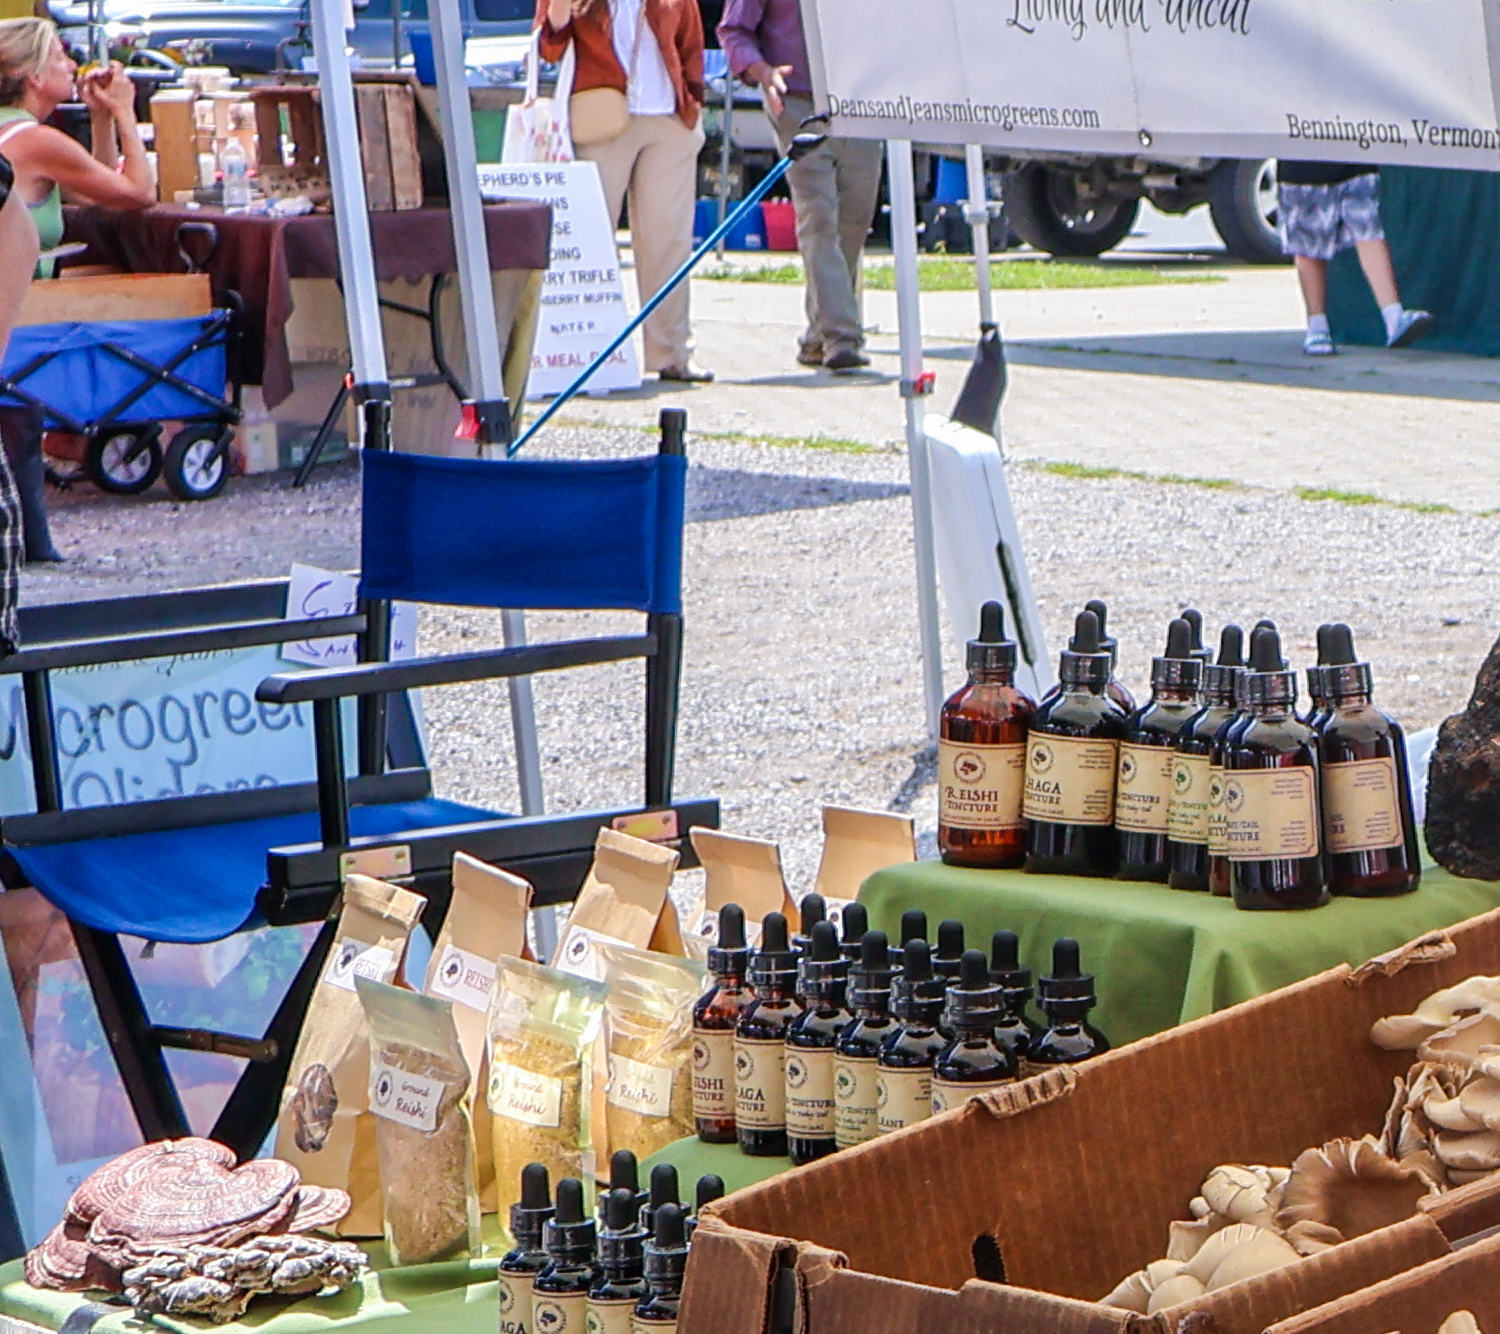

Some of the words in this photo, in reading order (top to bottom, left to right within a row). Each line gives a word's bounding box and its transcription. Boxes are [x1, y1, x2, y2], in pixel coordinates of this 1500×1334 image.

[826, 93, 1101, 131] DeansandJeansmicrogreens.com
[1286, 114, 1409, 149] Bennington,
[545, 171, 566, 185] PIE
[570, 269, 615, 284] TRIFLE
[584, 291, 623, 304] MUFFIN
[547, 352, 586, 368] MEAL
[945, 786, 998, 802] REISHI
[946, 801, 998, 813] TINCTURE
[463, 966, 494, 992] REISHI
[396, 1098, 428, 1119] Reishi
